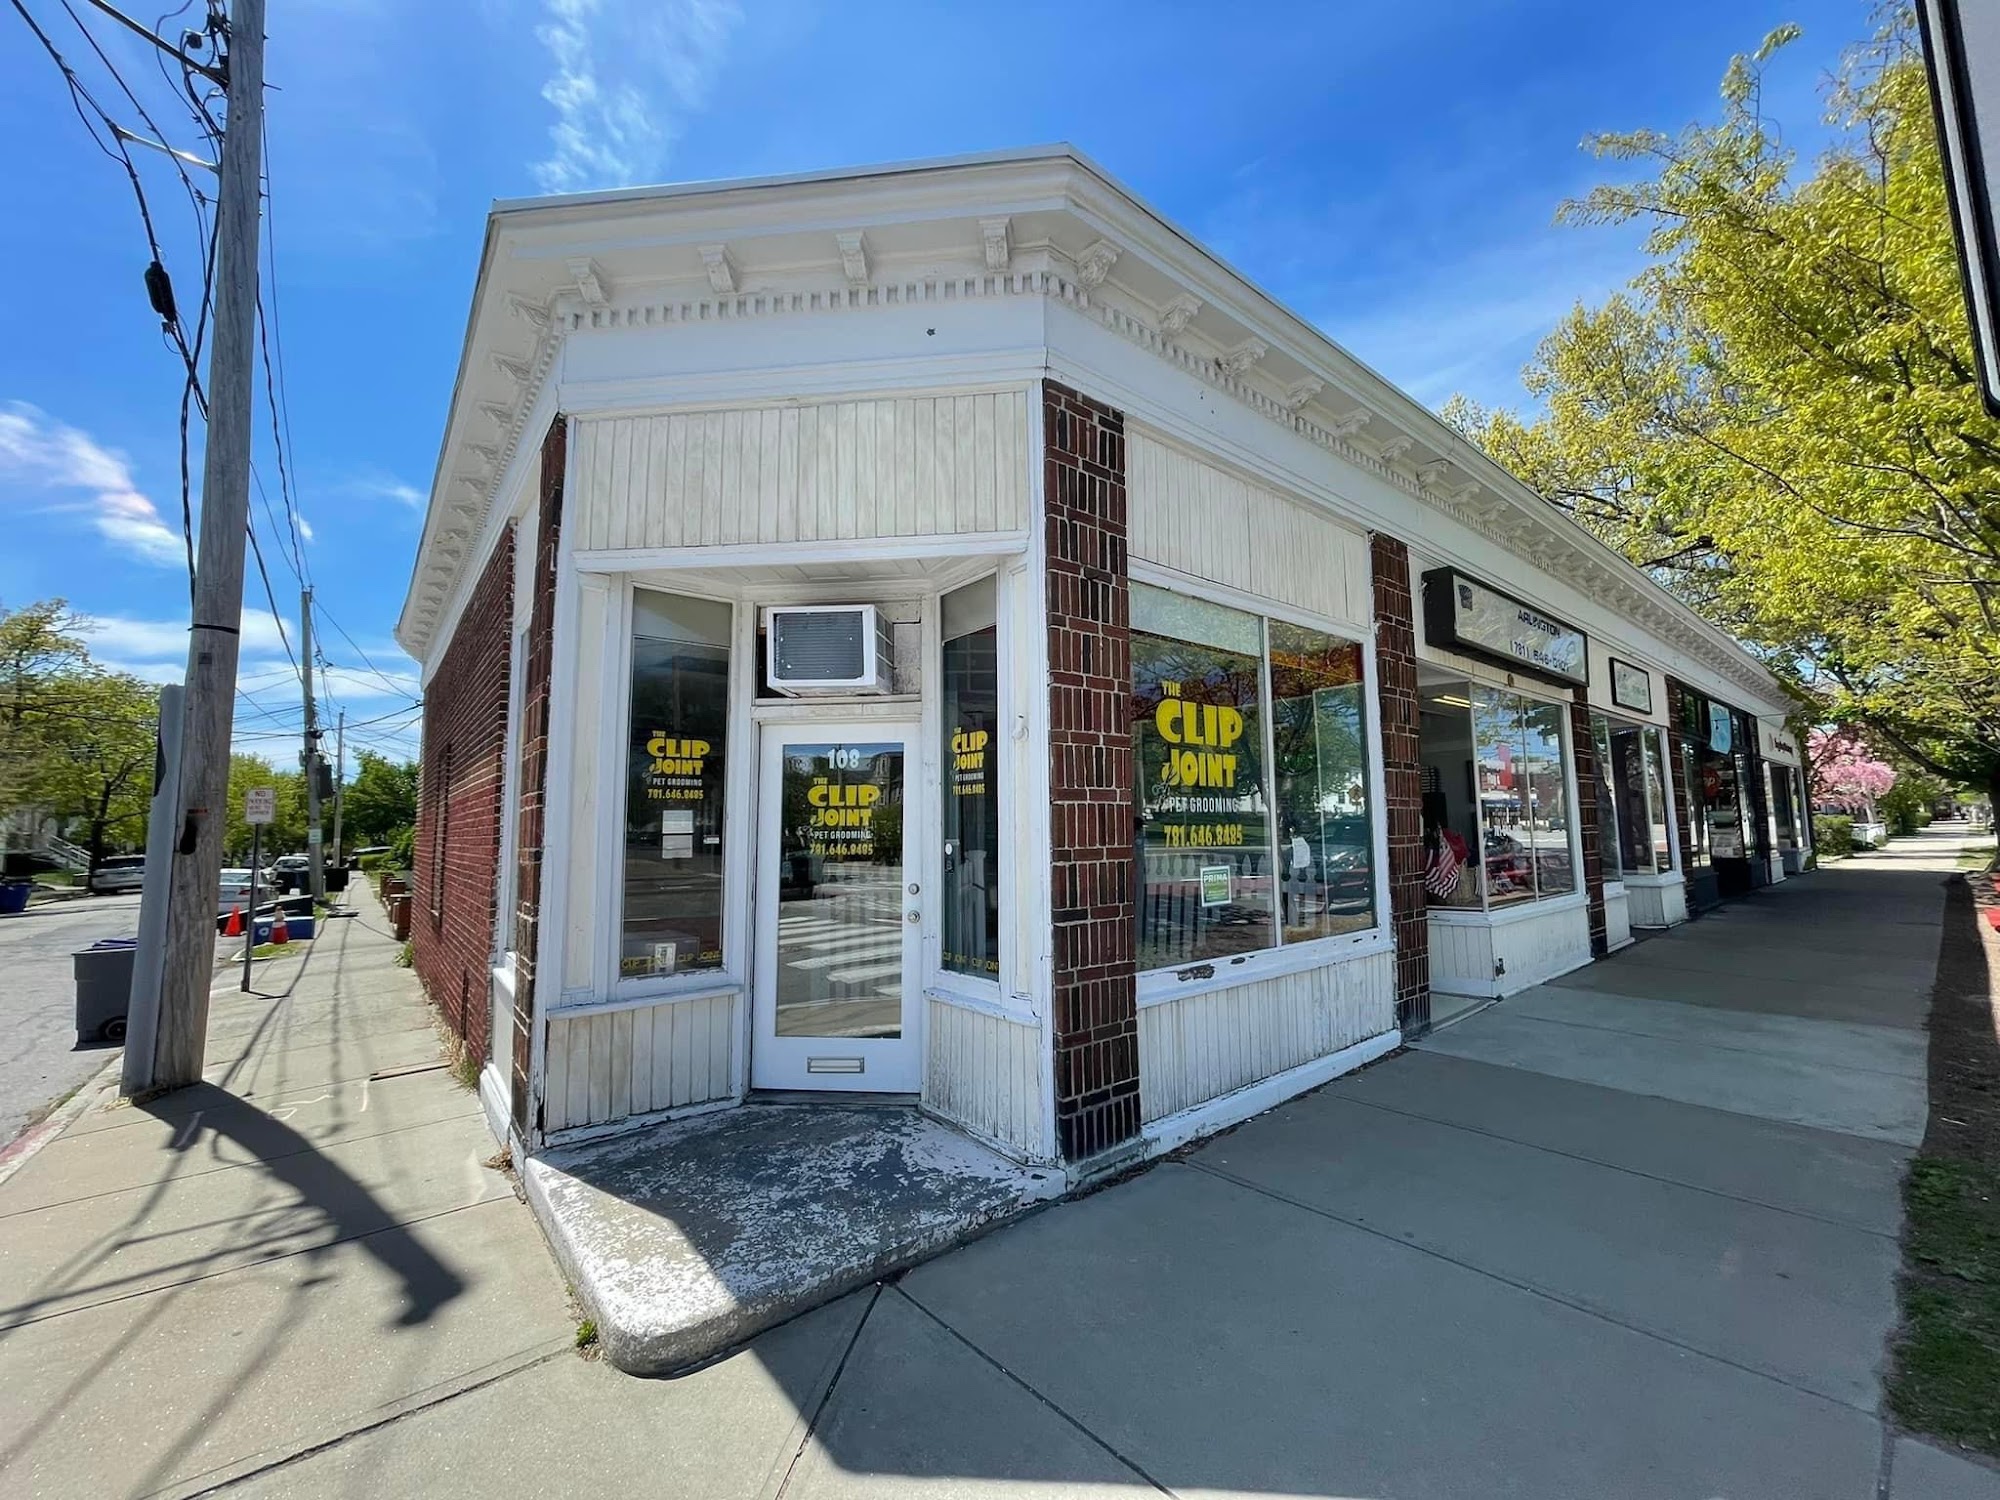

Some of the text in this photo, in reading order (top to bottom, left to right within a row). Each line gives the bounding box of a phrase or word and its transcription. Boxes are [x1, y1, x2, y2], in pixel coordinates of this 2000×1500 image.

[1518, 610, 1561, 638] ARLINGTON
[1162, 680, 1181, 697] THE
[1156, 698, 1243, 748] CLIP
[652, 730, 666, 738] THE
[952, 730, 988, 754] CLIP
[646, 737, 711, 759] CLIP
[648, 757, 704, 775] JOINT
[827, 748, 860, 770] 108
[953, 752, 985, 772] JOINT
[1161, 748, 1237, 788] JOINT
[652, 777, 666, 786] PET
[813, 777, 828, 785] THE
[807, 784, 881, 807] CLIP
[1169, 795, 1239, 814] PET GROOMING
[809, 808, 873, 828] JOINT
[814, 830, 873, 840] PET GROOMING
[1163, 824, 1243, 848] 781.646.8485
